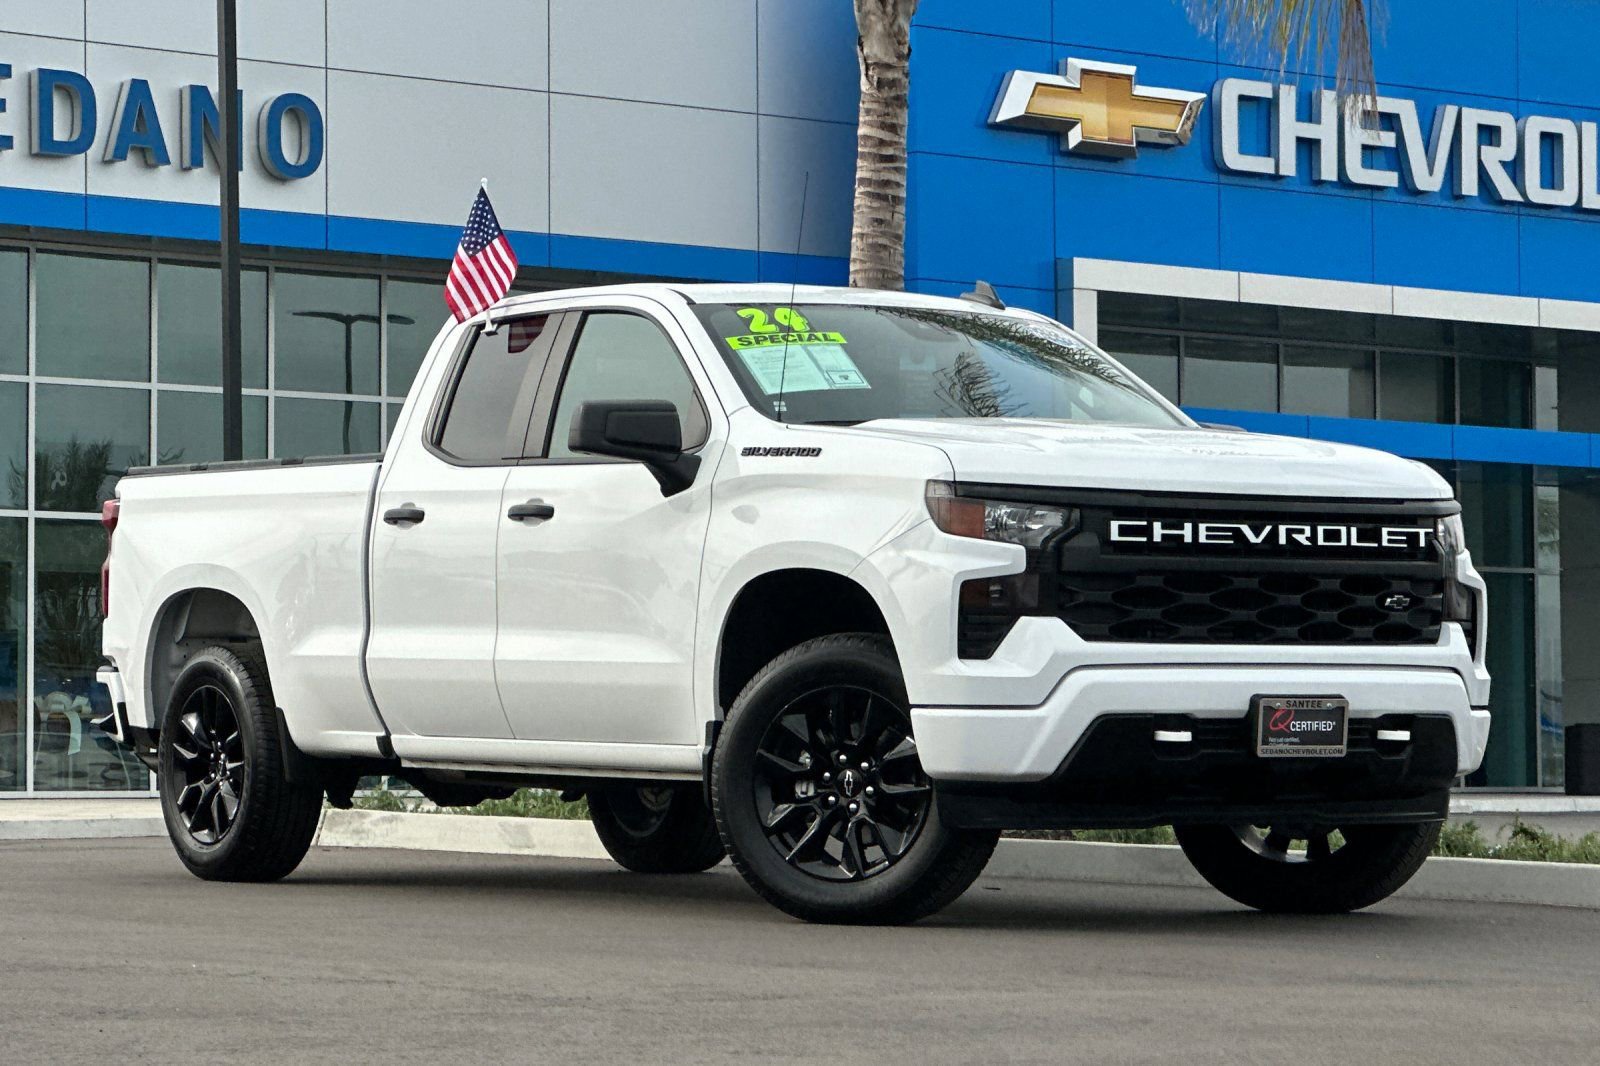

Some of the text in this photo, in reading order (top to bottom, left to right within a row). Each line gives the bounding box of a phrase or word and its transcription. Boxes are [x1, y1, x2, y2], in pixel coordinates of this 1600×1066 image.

[738, 333, 836, 346] SPECIAL
[741, 447, 822, 457] SILVERADO
[1110, 520, 1434, 547] CHEVROLET
[1286, 700, 1323, 708] SANTEE
[1261, 748, 1344, 756] SEDANOCHEVROLET.COM
